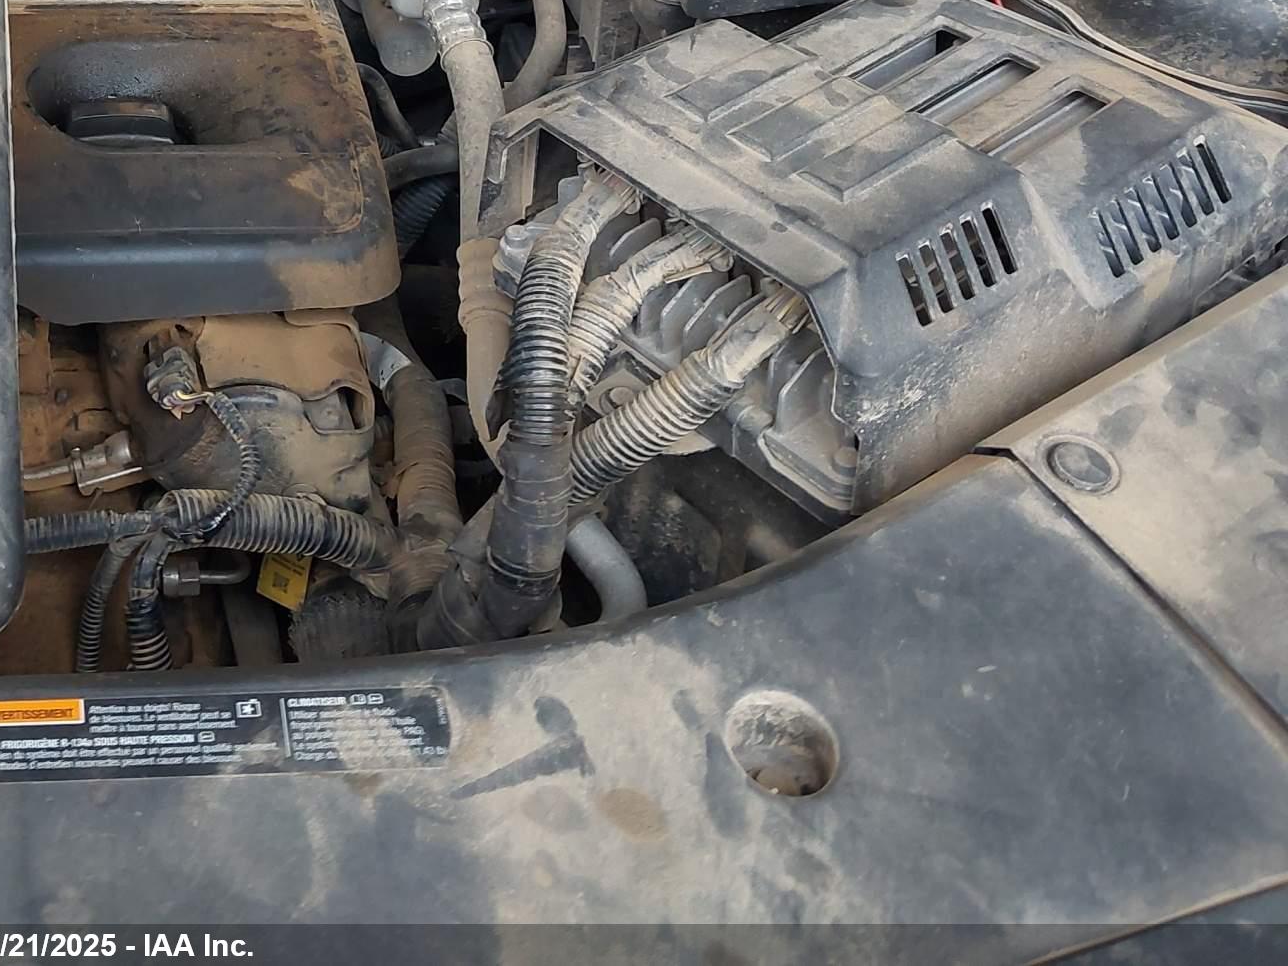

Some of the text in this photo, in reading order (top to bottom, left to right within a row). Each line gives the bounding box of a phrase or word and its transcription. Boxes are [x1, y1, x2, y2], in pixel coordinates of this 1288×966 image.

[287, 697, 347, 708] CLIMATISEUR
[89, 705, 126, 714] Attention
[93, 736, 119, 746] SOUS
[119, 735, 150, 745] HAUTE
[150, 734, 195, 744] PRESSION
